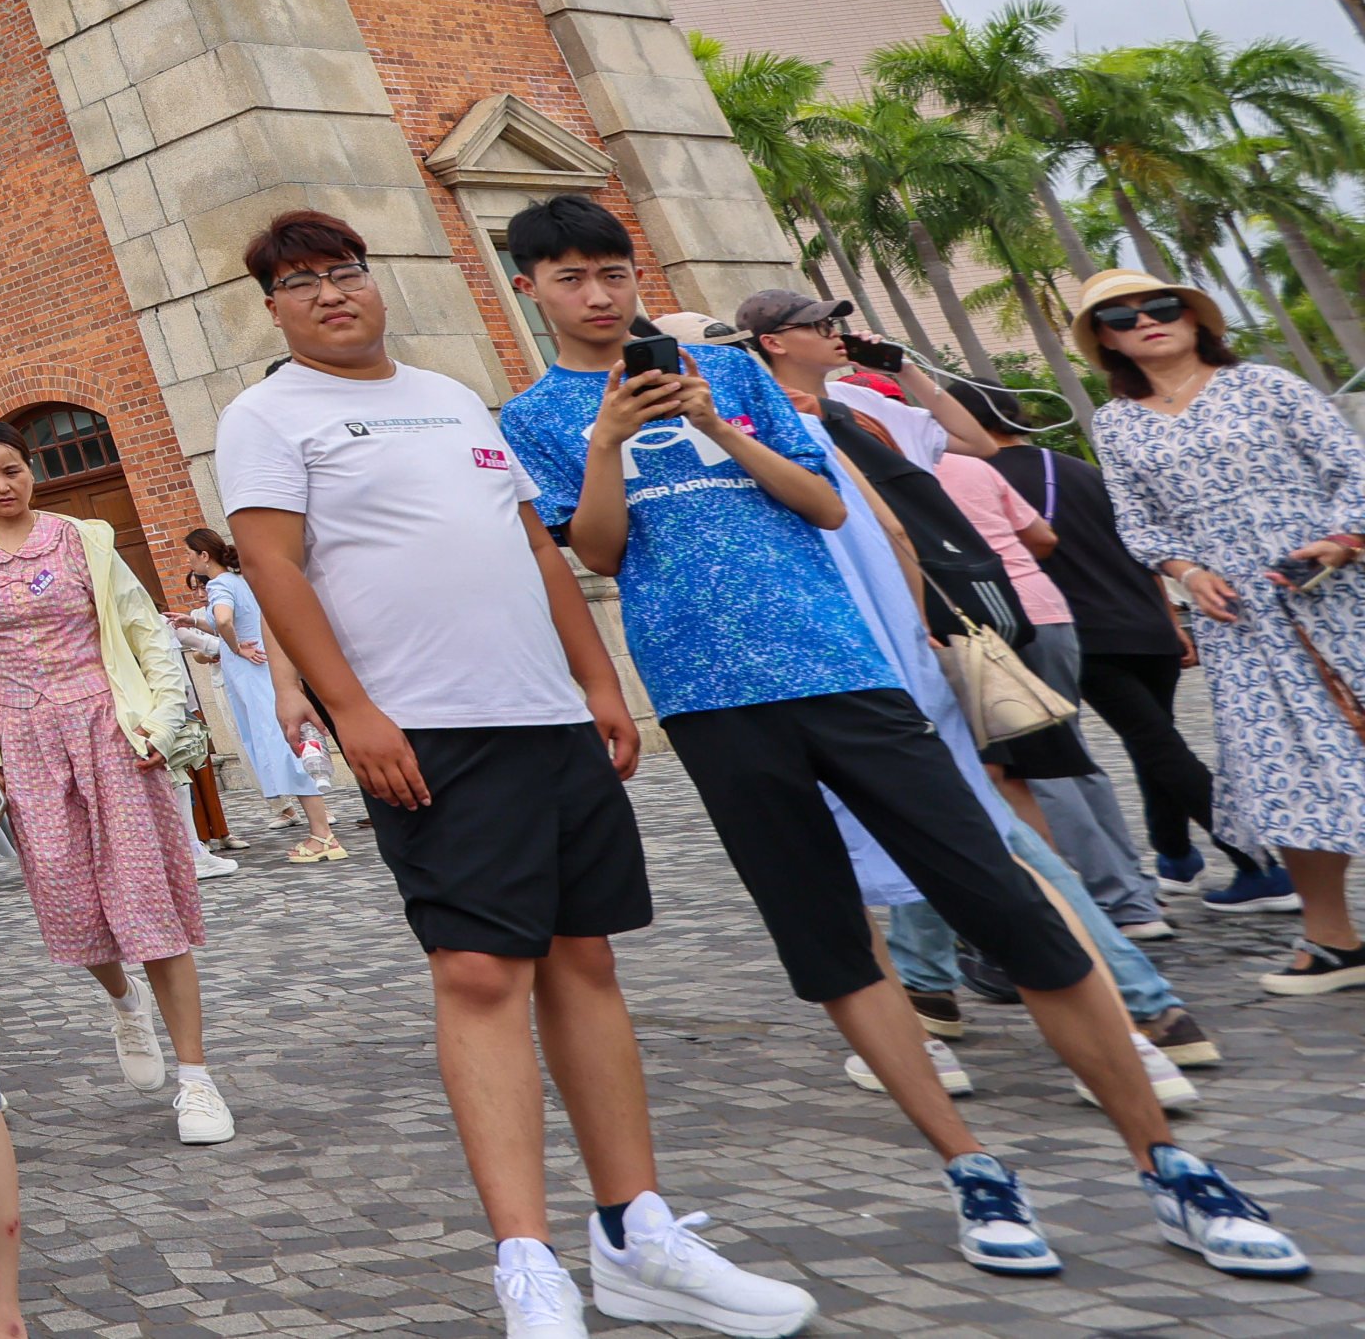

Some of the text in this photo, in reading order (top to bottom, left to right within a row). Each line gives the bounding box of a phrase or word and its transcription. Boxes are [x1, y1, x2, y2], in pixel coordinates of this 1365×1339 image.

[474, 449, 485, 466] 9
[673, 478, 757, 494] ARMOUR
[30, 583, 42, 596] 3
